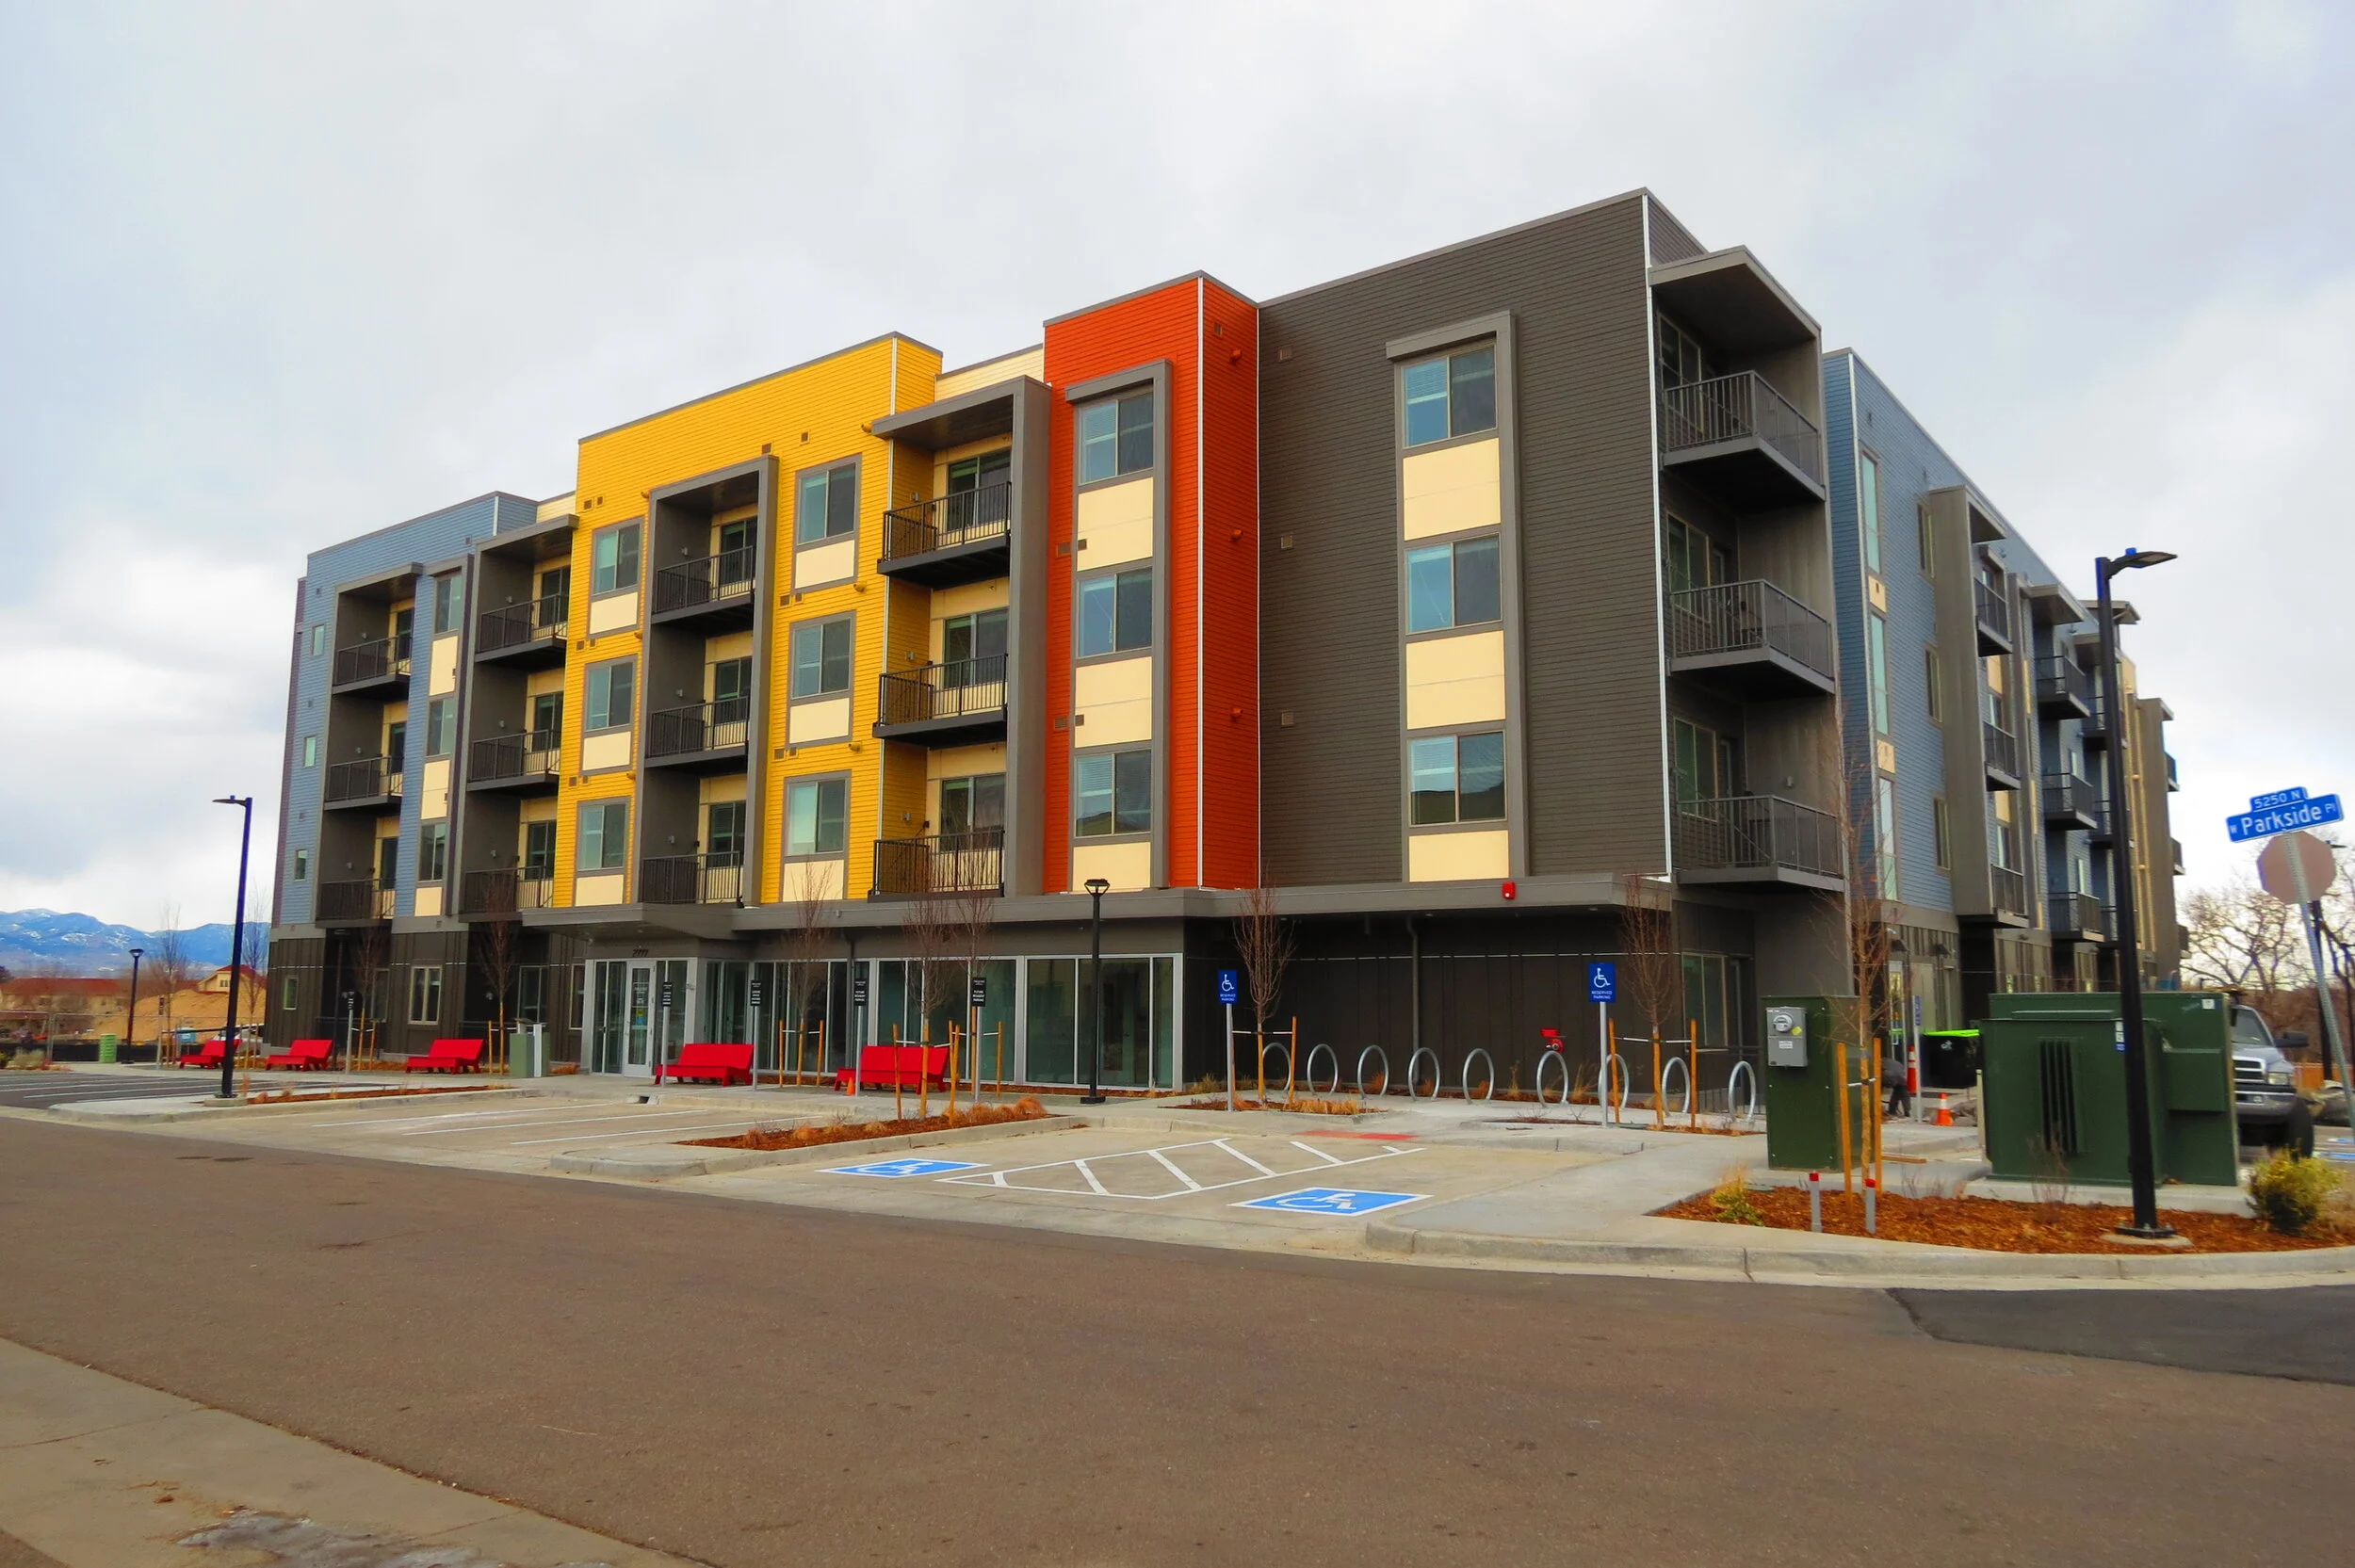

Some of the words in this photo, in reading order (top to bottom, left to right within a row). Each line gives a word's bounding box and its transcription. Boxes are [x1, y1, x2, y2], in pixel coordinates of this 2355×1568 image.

[2253, 793, 2287, 809] 5250
[2291, 789, 2301, 800] N
[2240, 803, 2322, 836] Parkside
